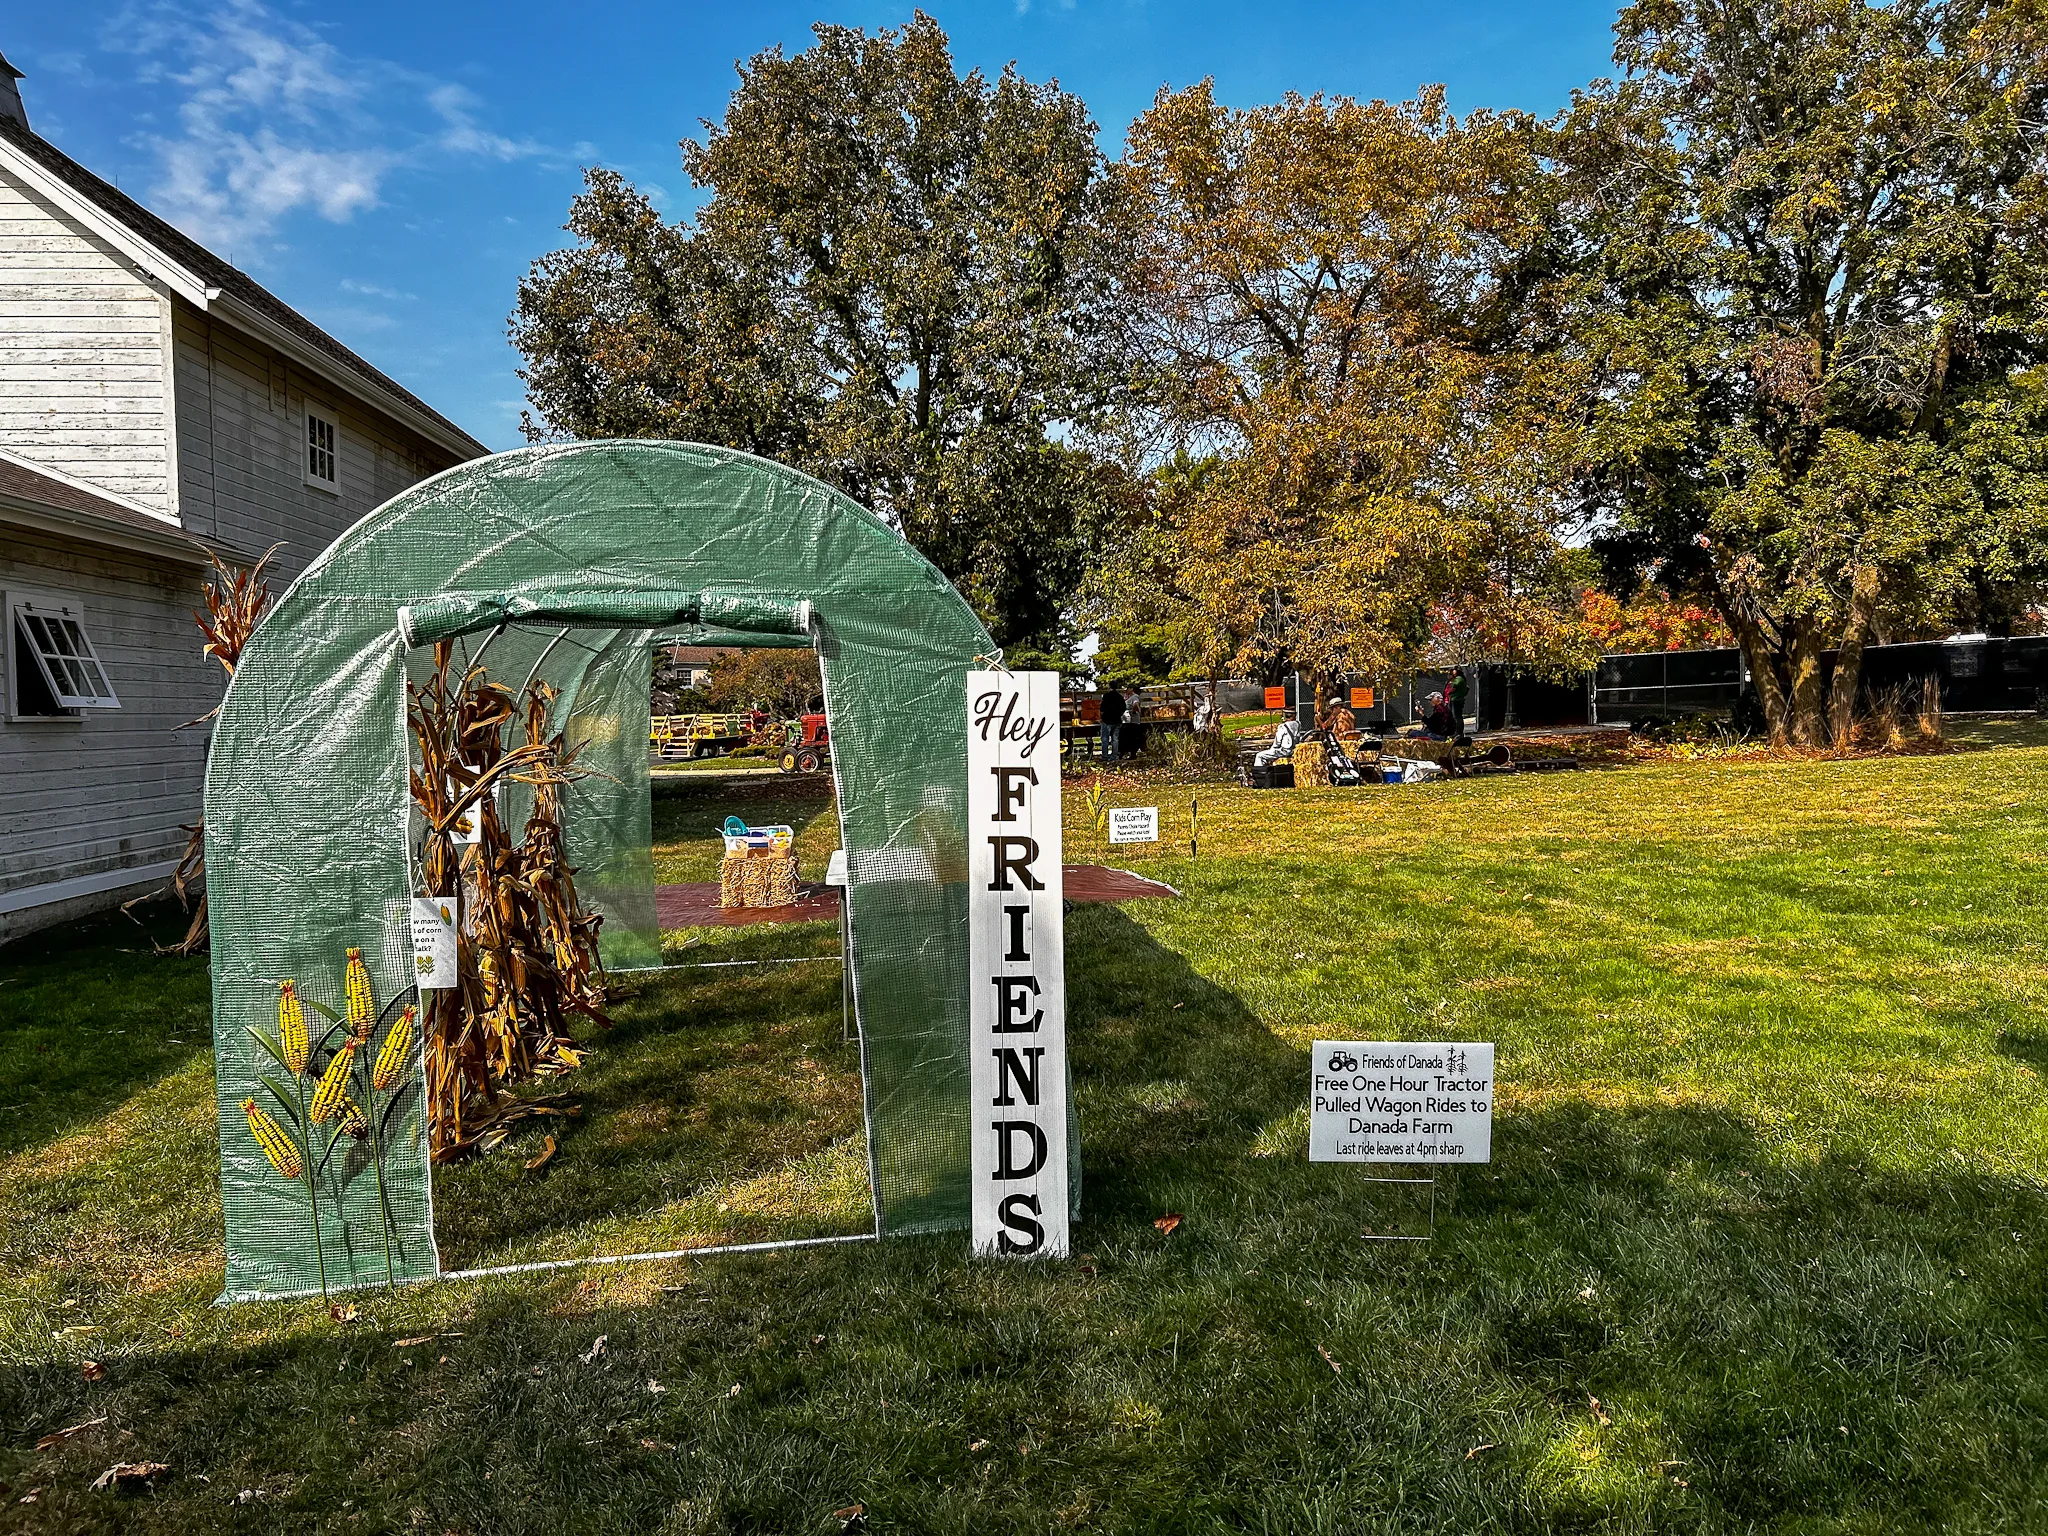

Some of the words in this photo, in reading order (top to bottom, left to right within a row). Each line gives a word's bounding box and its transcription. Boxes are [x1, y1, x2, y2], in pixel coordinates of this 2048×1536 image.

[974, 691, 1055, 759] Hey
[1114, 813, 1126, 822] Kids
[1127, 813, 1139, 821] Corn
[1140, 812, 1152, 823] Play
[987, 766, 1048, 1255] FRIENDS
[1362, 1054, 1395, 1069] Friends
[1396, 1054, 1407, 1069] of
[1408, 1054, 1443, 1069] Danada
[1315, 1075, 1348, 1091] Free
[1352, 1076, 1386, 1091] One
[1390, 1076, 1429, 1092] Hour
[1433, 1076, 1488, 1092] Tractor
[1315, 1097, 1361, 1113] Pulled
[1365, 1097, 1422, 1117] Wagon
[1426, 1097, 1466, 1113] Rides
[1471, 1099, 1487, 1113] to
[1349, 1118, 1408, 1134] Danada
[1412, 1118, 1453, 1134] Farm
[1336, 1141, 1356, 1155] Last
[1357, 1141, 1375, 1155] ride
[1376, 1141, 1403, 1155] leaves
[1405, 1142, 1415, 1155] at
[1416, 1141, 1438, 1158] 4pm
[1439, 1141, 1464, 1158] sharp
